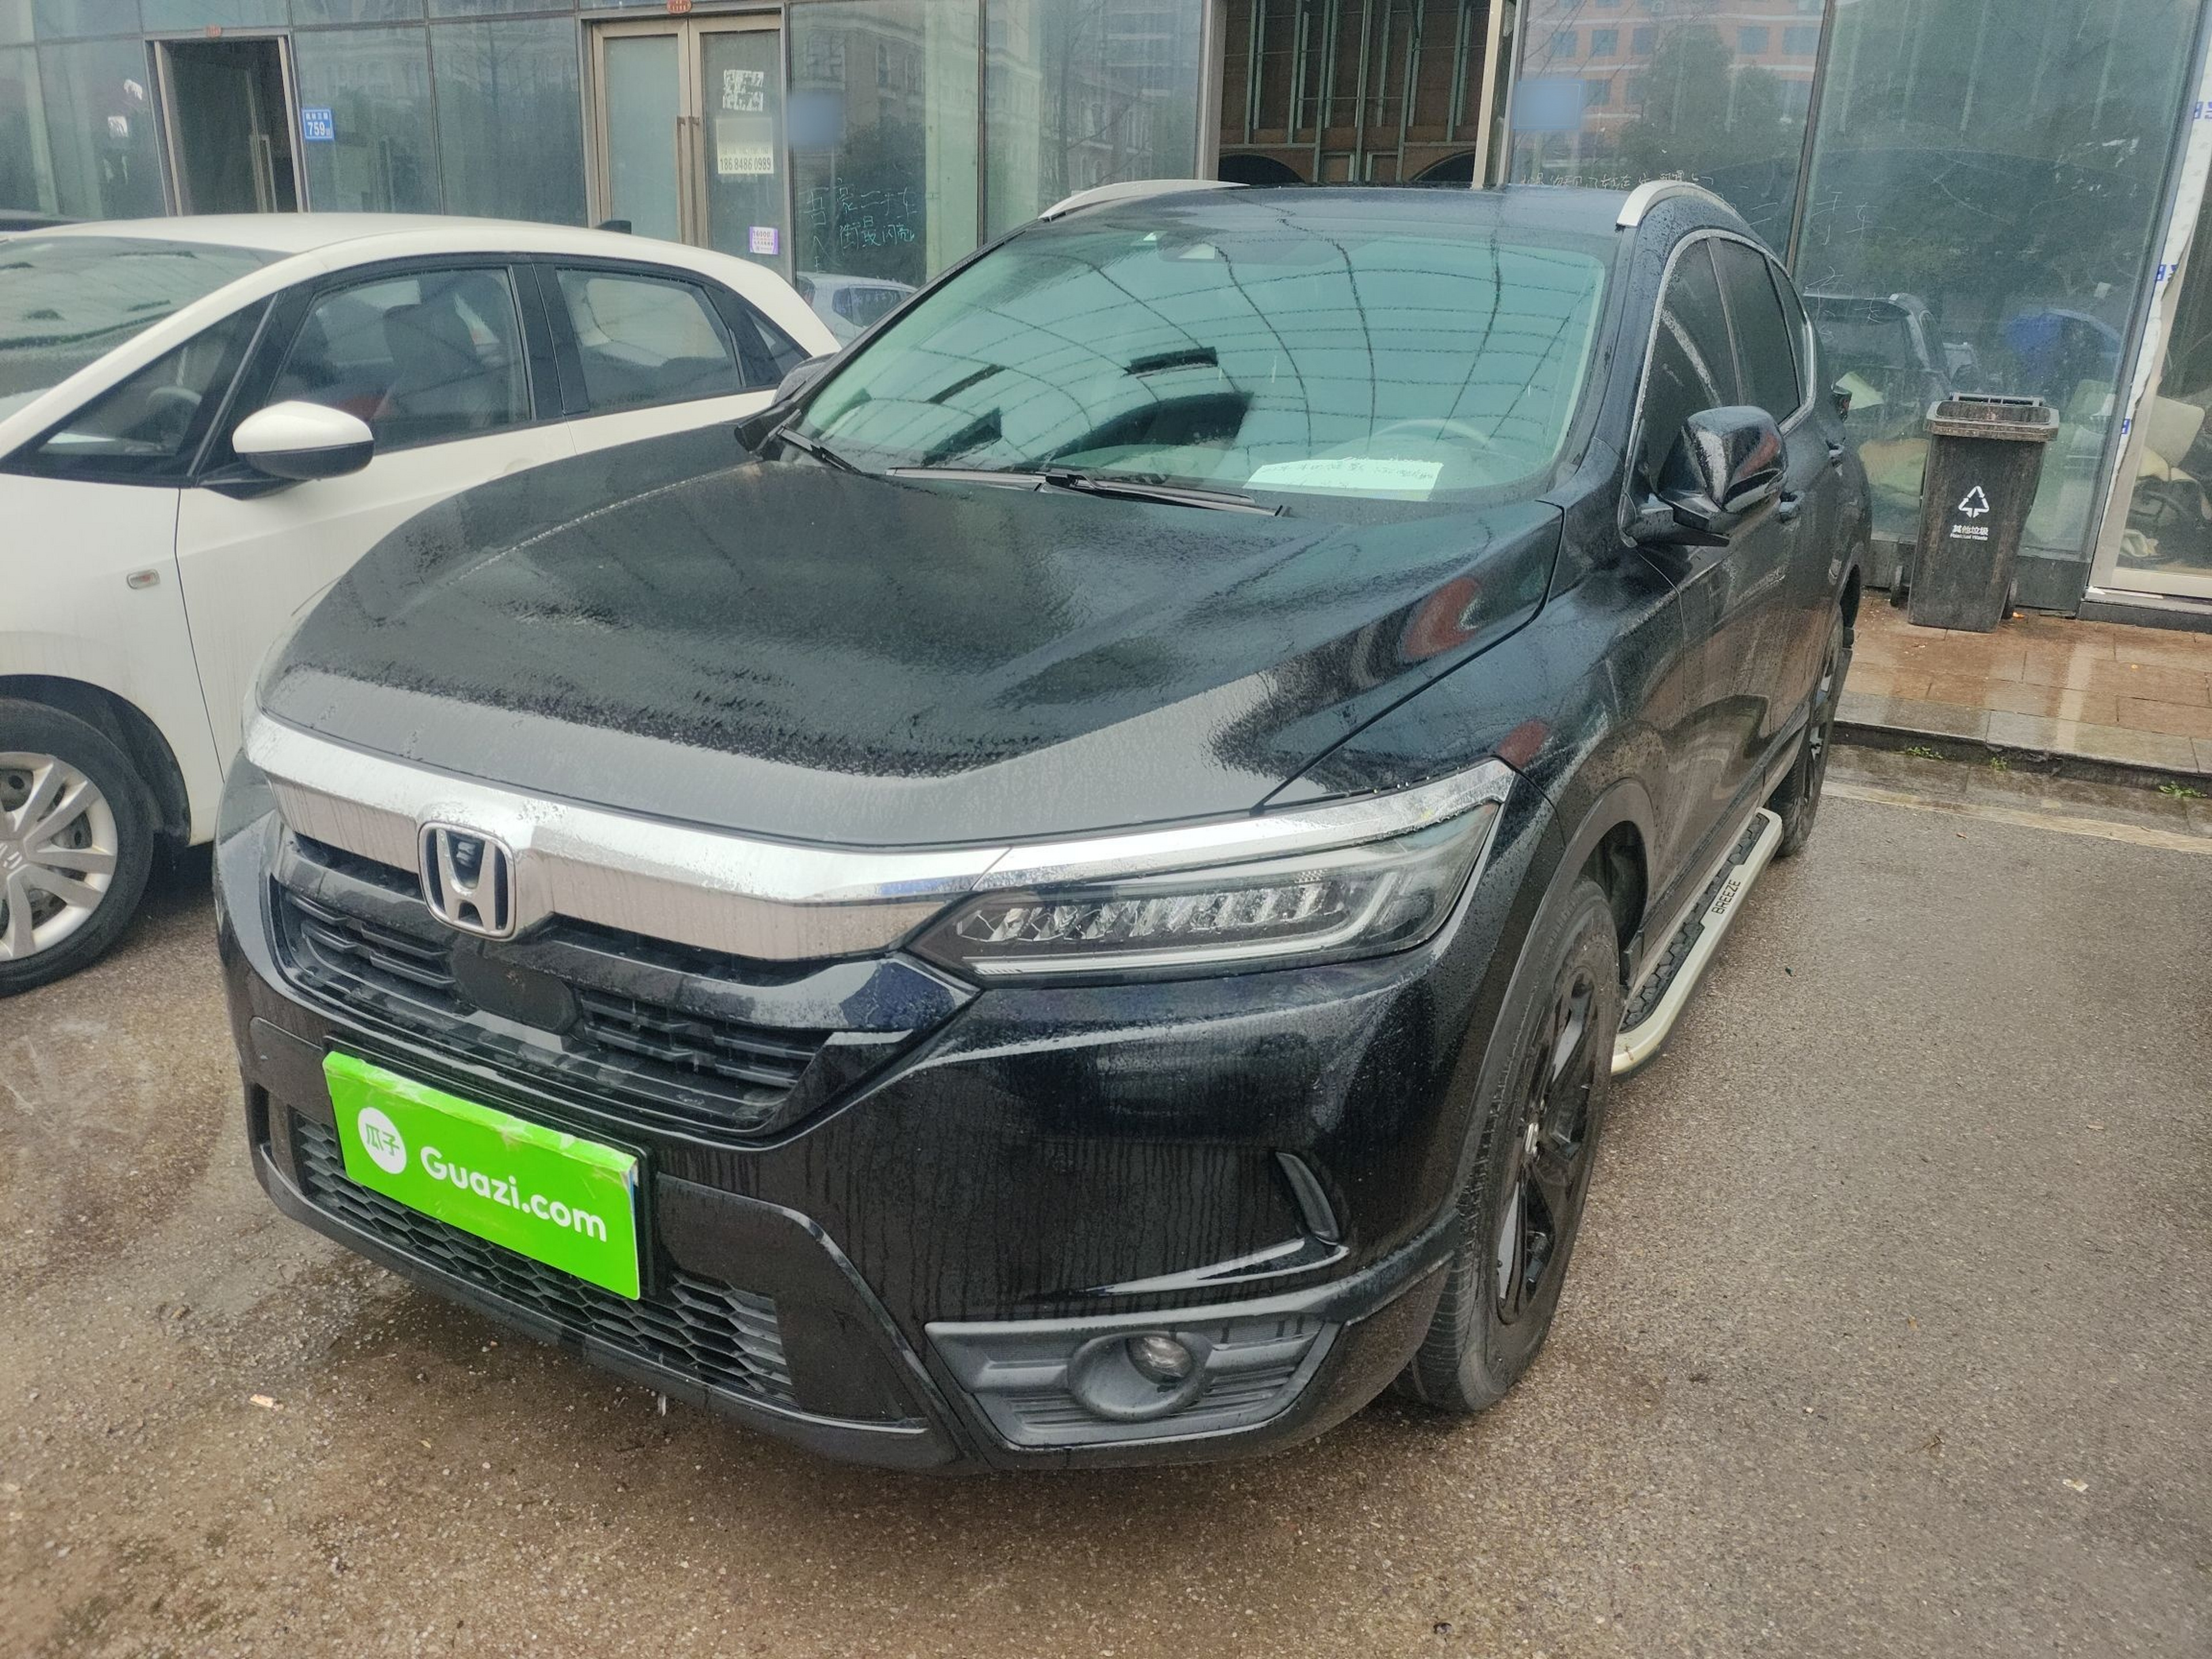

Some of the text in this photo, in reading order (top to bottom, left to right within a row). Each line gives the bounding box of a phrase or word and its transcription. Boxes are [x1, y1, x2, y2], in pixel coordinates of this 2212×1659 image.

[1711, 880, 1741, 914] BREEZE
[365, 1123, 400, 1157] 瓜子
[419, 1146, 608, 1243] Guazi.com
